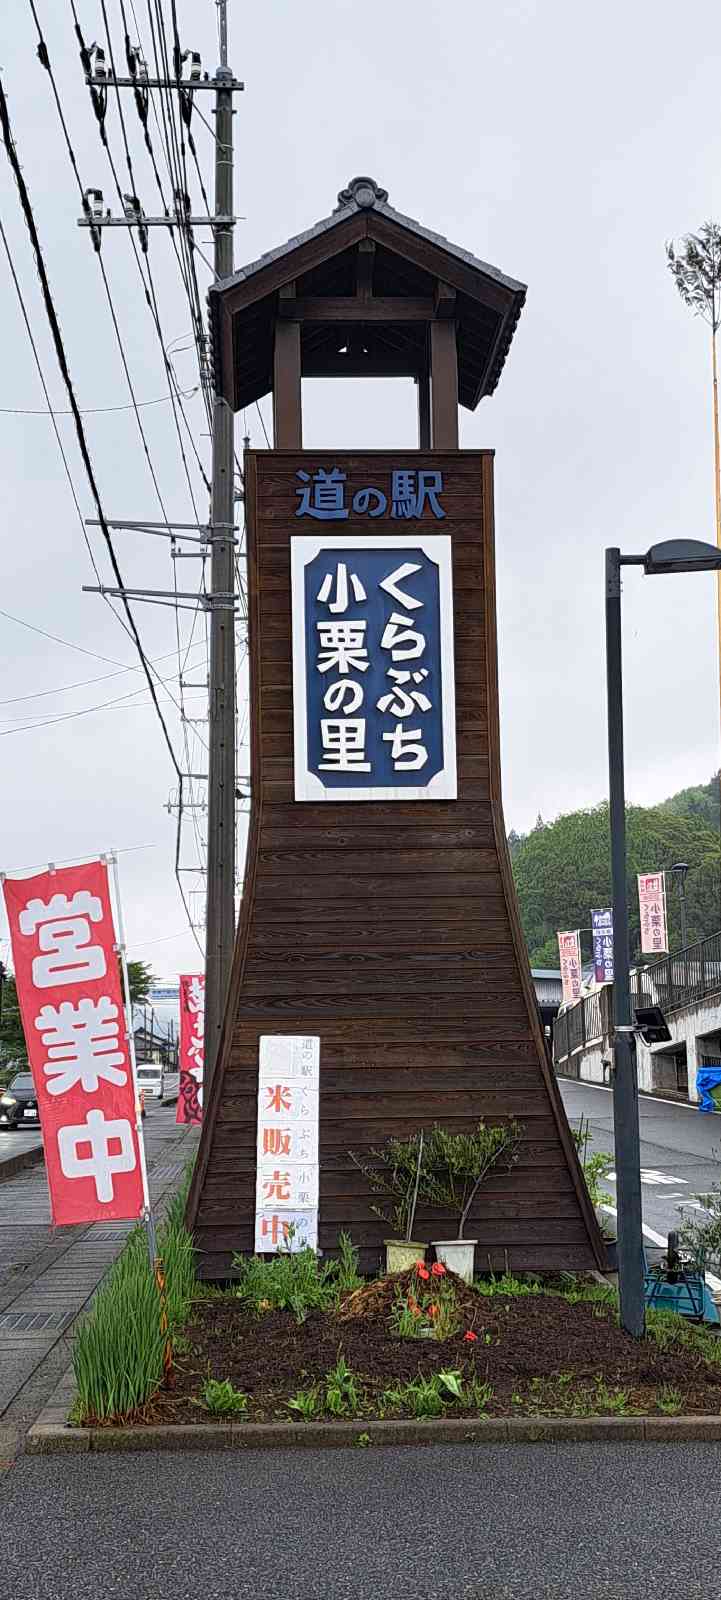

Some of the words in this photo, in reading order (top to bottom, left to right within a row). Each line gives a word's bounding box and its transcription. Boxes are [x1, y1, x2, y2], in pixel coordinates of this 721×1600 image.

[295, 468, 447, 520] 道の駅
[316, 562, 372, 773] 小栗の里
[376, 562, 433, 772] くらぶち
[18, 889, 138, 1204] 営業中
[261, 1084, 292, 1245] 米販売中
